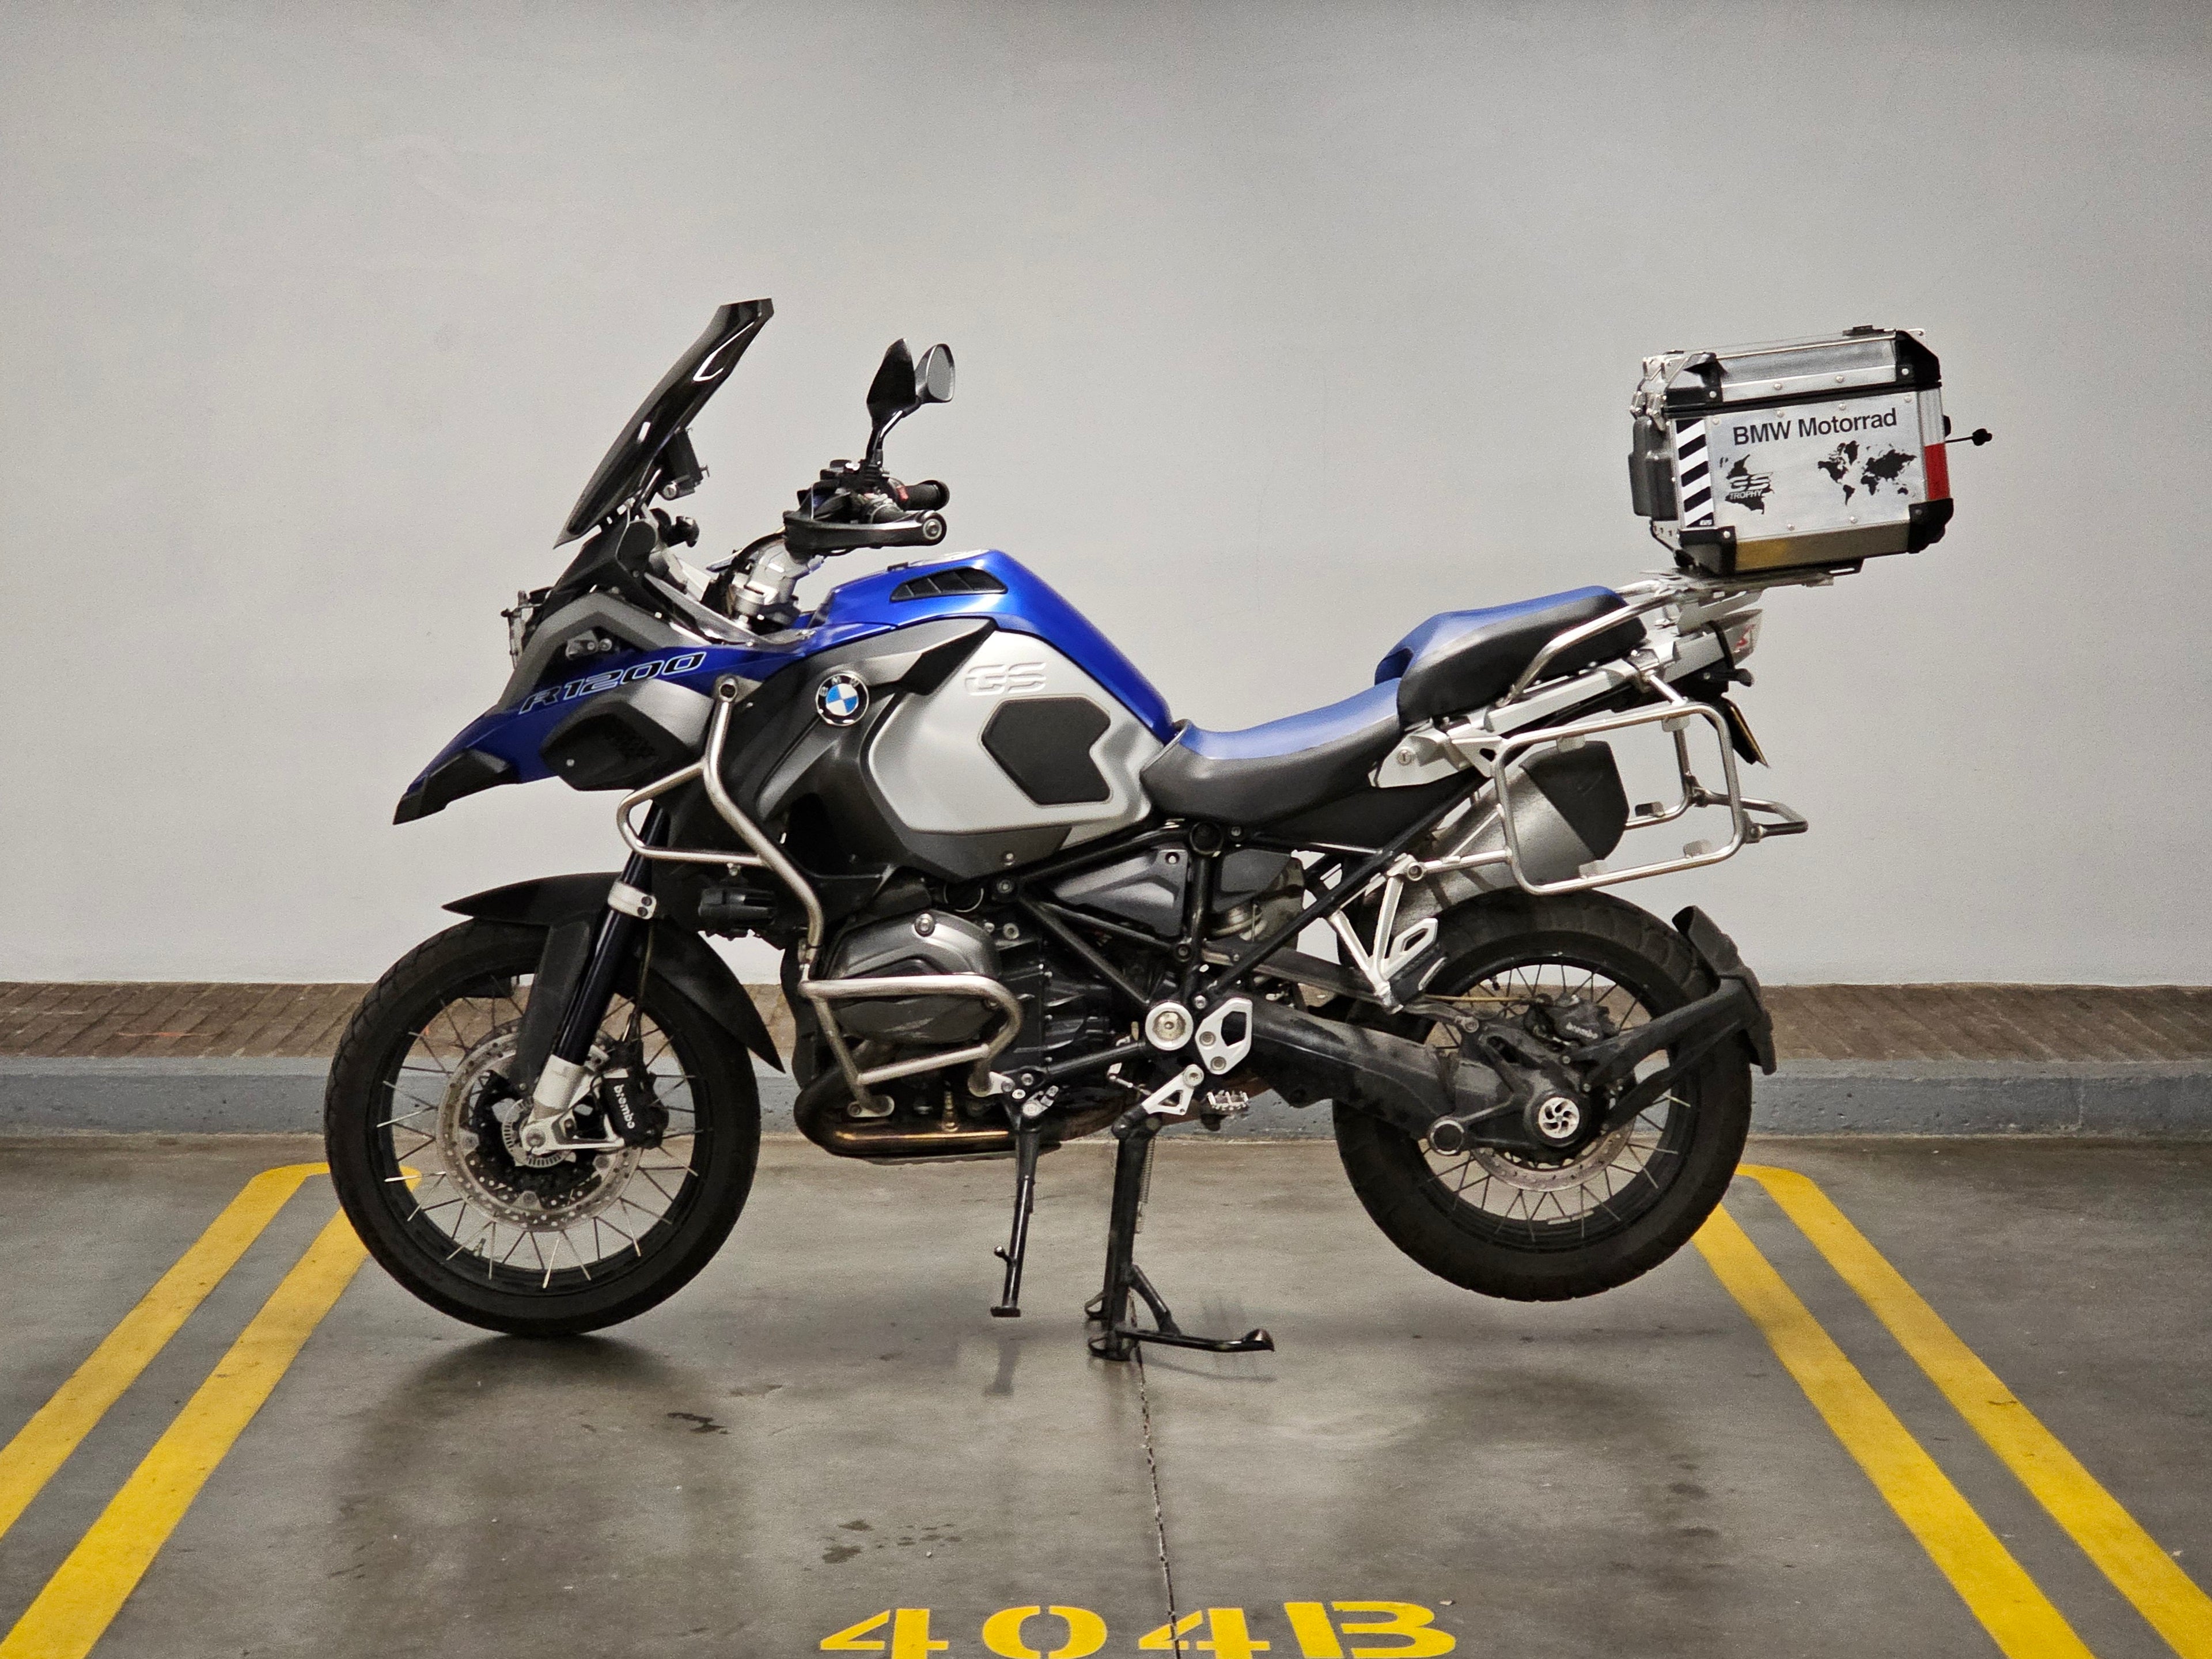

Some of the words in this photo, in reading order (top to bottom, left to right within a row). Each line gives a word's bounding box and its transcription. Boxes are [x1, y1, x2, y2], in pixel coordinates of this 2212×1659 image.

[1733, 420, 1791, 445] BMW
[1798, 407, 1897, 438] Motorrad
[1729, 490, 1763, 500] TROPHY
[518, 652, 707, 714] R1200
[964, 662, 1047, 695] GS
[613, 1084, 635, 1129] brembo
